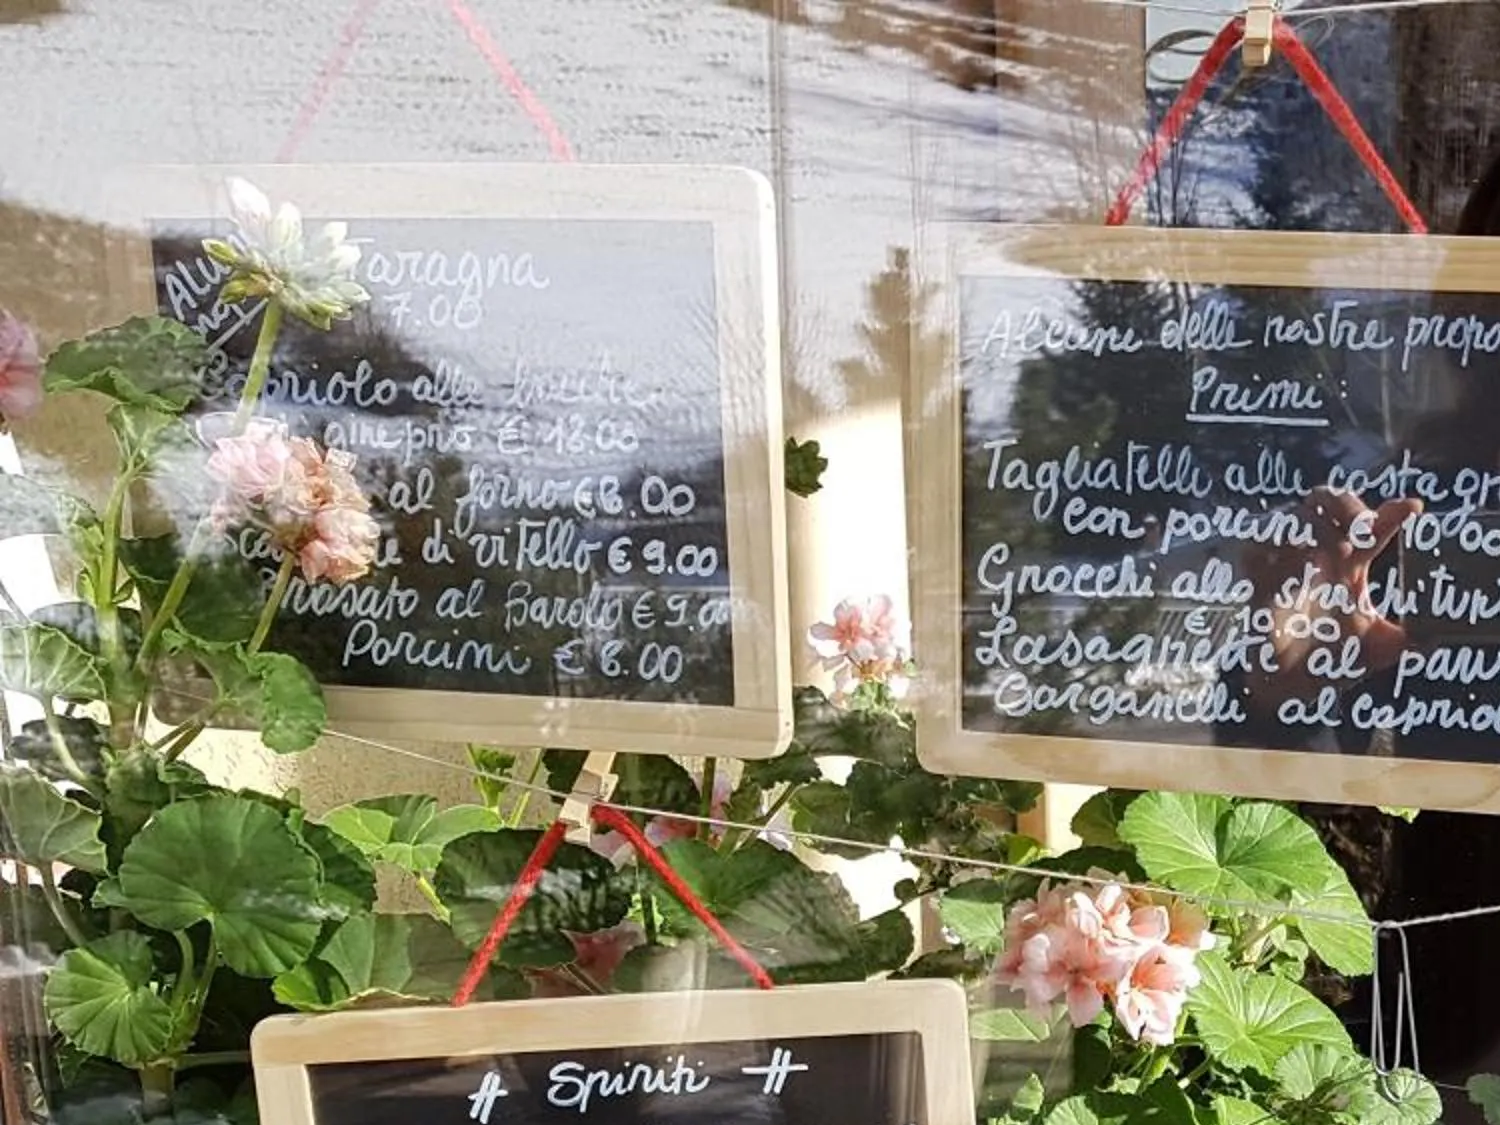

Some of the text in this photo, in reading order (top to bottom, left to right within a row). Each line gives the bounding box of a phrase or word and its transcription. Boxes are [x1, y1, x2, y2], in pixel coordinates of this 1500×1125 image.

[1161, 301, 1254, 353] delle
[1264, 301, 1395, 354] nostre
[388, 465, 572, 538] al forno
[1162, 500, 1318, 556] porcini
[1350, 511, 1377, 551] €
[422, 519, 456, 566] di
[608, 537, 633, 575] €
[642, 538, 719, 577] 9.00
[436, 580, 482, 619] al
[631, 592, 656, 629] €
[342, 618, 532, 675] Porcini
[553, 639, 585, 675] €
[1307, 640, 1367, 682] al
[1279, 688, 1343, 727] al
[547, 1060, 713, 1113] Spiriti
